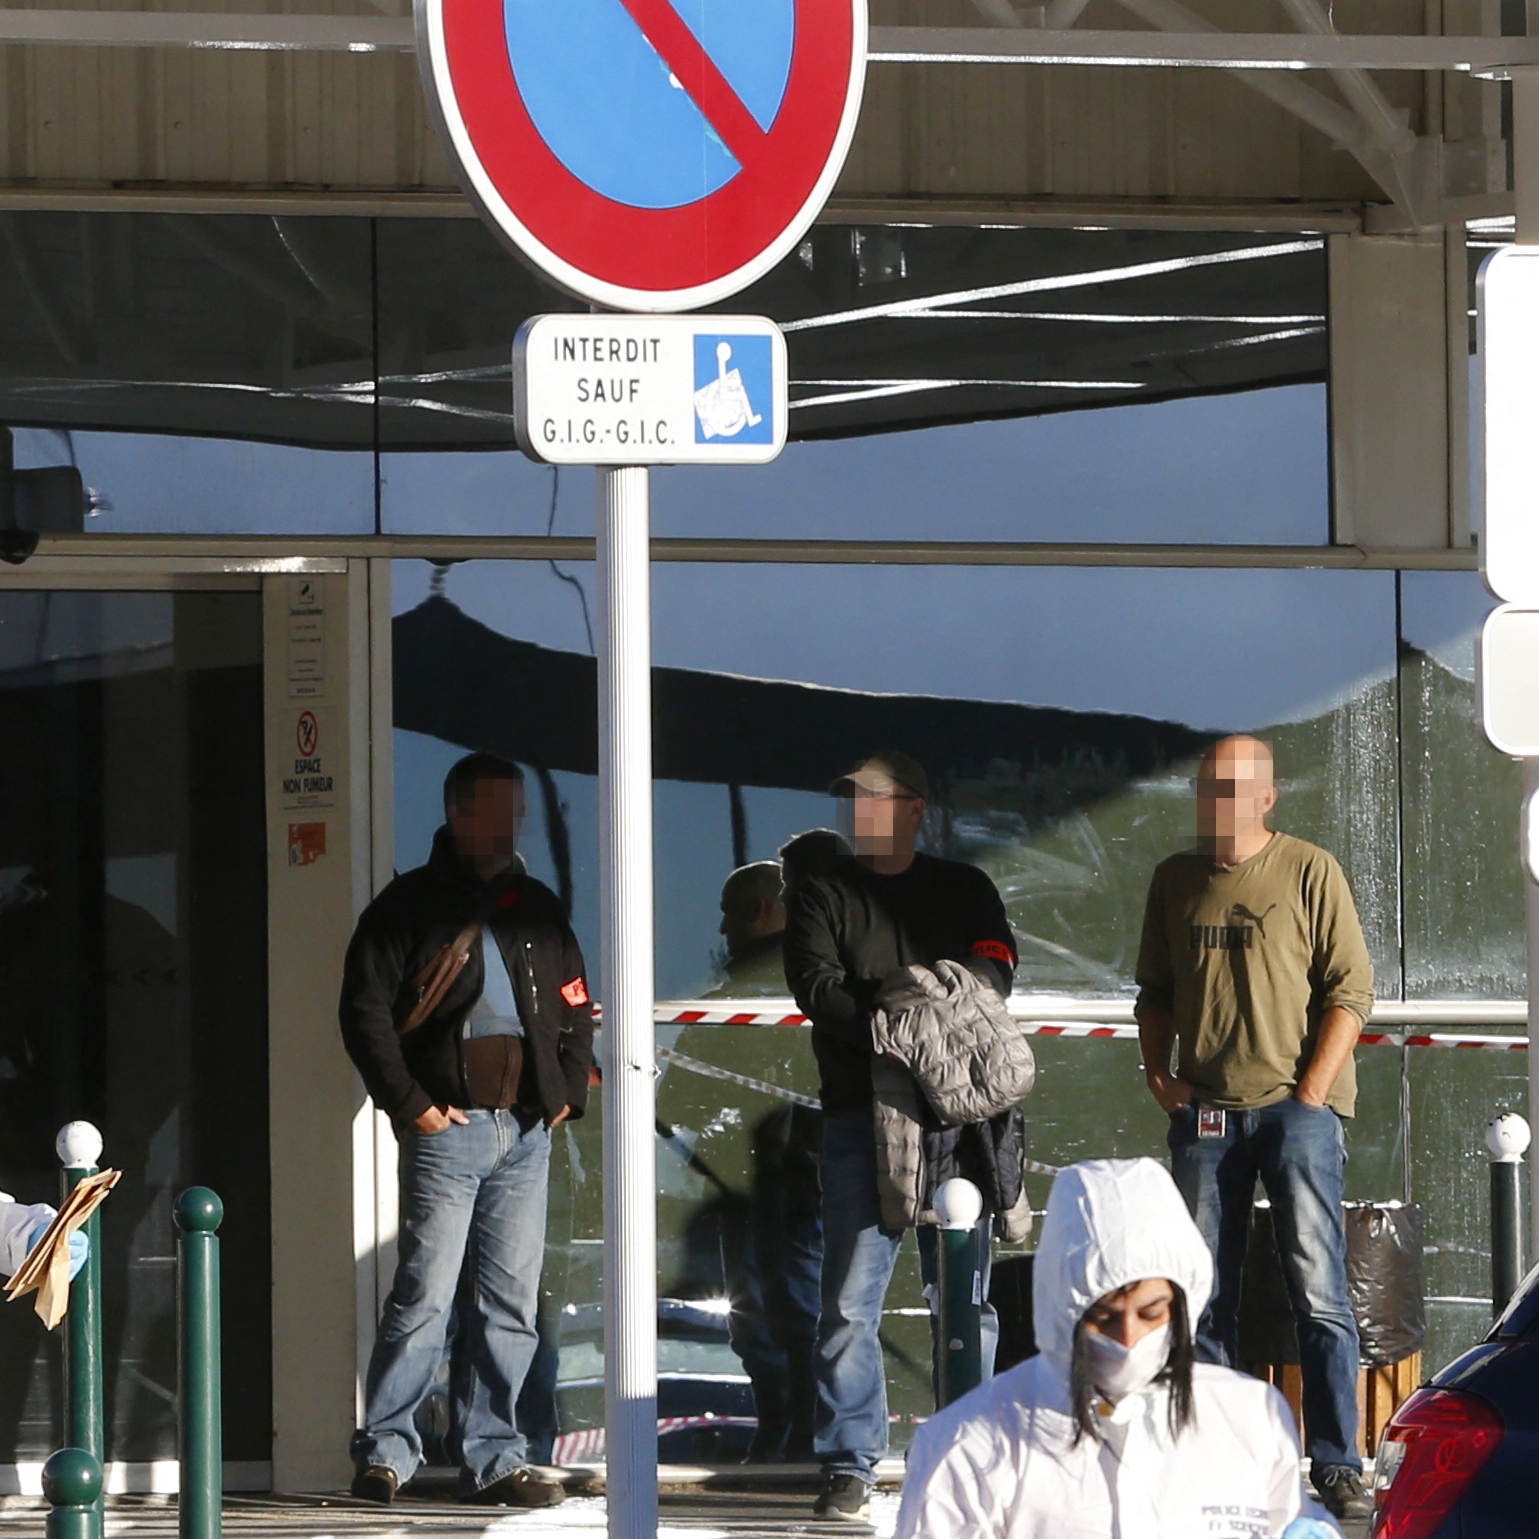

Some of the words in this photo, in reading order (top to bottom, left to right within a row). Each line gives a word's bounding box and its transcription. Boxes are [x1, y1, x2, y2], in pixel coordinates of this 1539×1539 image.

[554, 337, 661, 363] INTERDIT
[577, 378, 641, 403] SAUF
[543, 418, 675, 444] G.I.G.-G.I.C.
[295, 758, 321, 774] ESPACE
[283, 779, 301, 794] NON
[303, 777, 334, 792] FUMEUR
